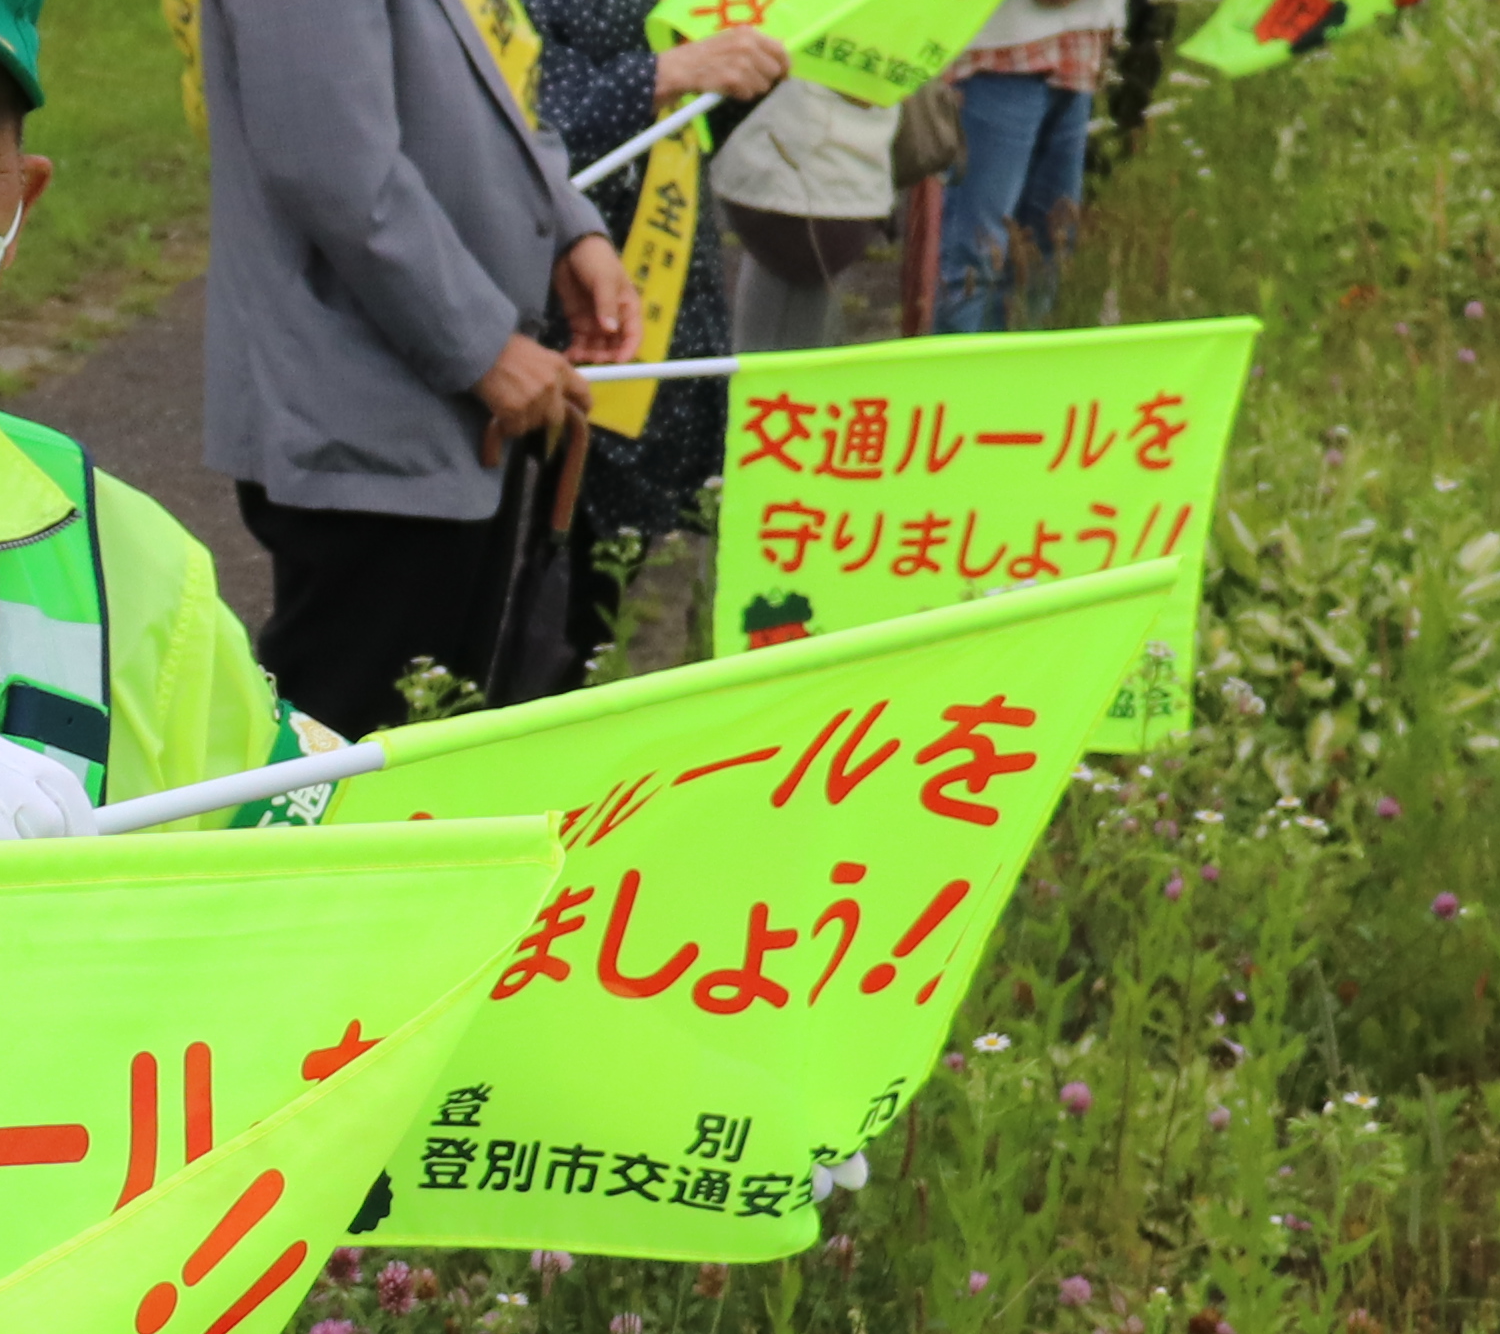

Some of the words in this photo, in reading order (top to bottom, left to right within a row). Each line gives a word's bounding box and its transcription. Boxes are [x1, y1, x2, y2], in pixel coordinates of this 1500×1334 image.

[738, 390, 1189, 480] 交通ルールを
